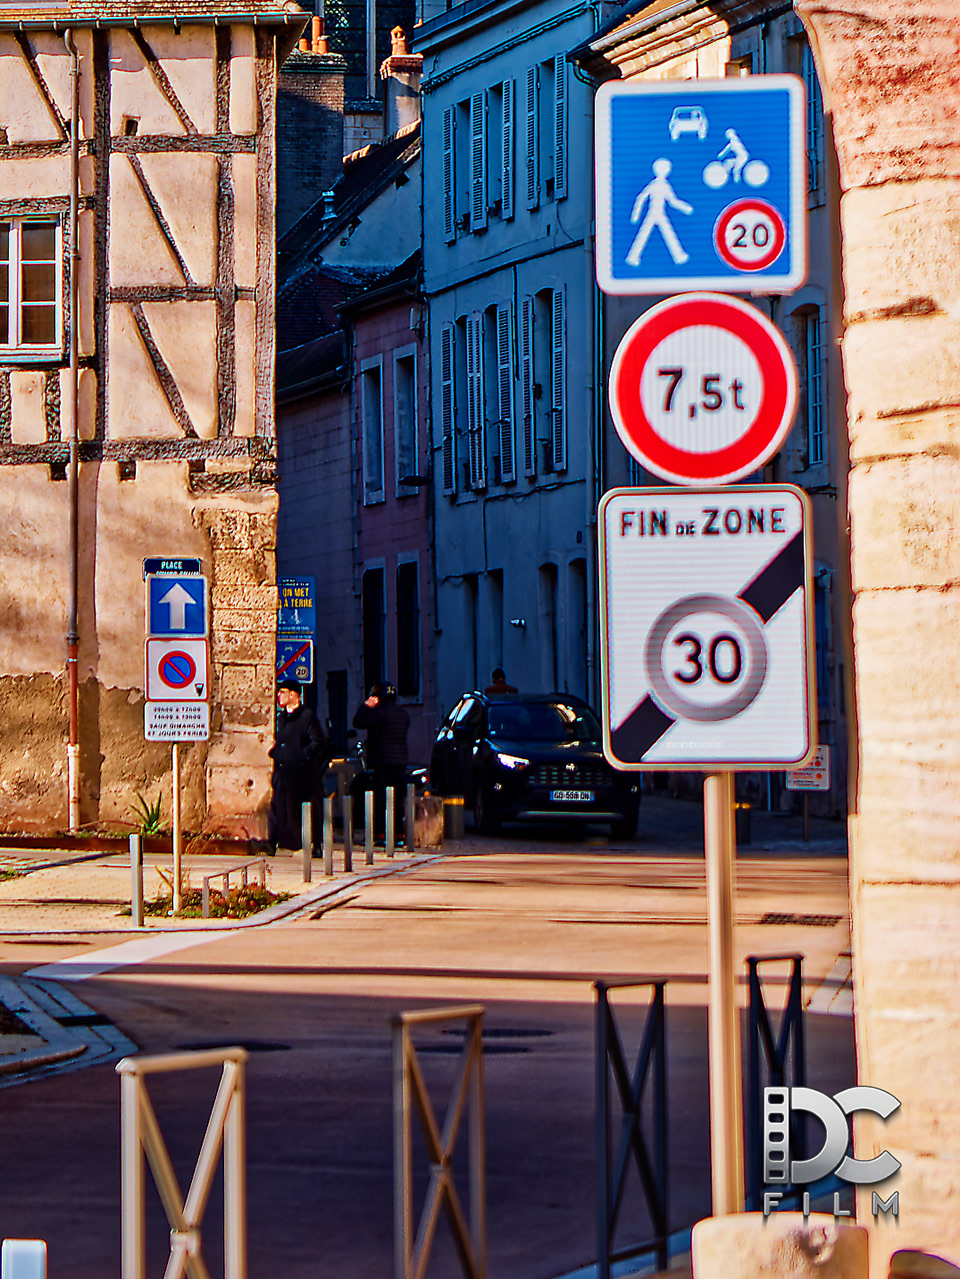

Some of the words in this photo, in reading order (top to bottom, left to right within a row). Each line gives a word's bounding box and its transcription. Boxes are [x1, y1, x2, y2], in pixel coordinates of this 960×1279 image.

[731, 223, 769, 249] 20
[657, 368, 745, 419] 7,5t
[620, 509, 668, 537] FIN
[675, 522, 696, 536] DE
[701, 507, 786, 535] ZONE
[161, 561, 183, 570] PLACE
[282, 587, 293, 597] ON
[294, 587, 309, 597] MET
[291, 598, 313, 608] TERRE
[672, 634, 742, 685] 30
